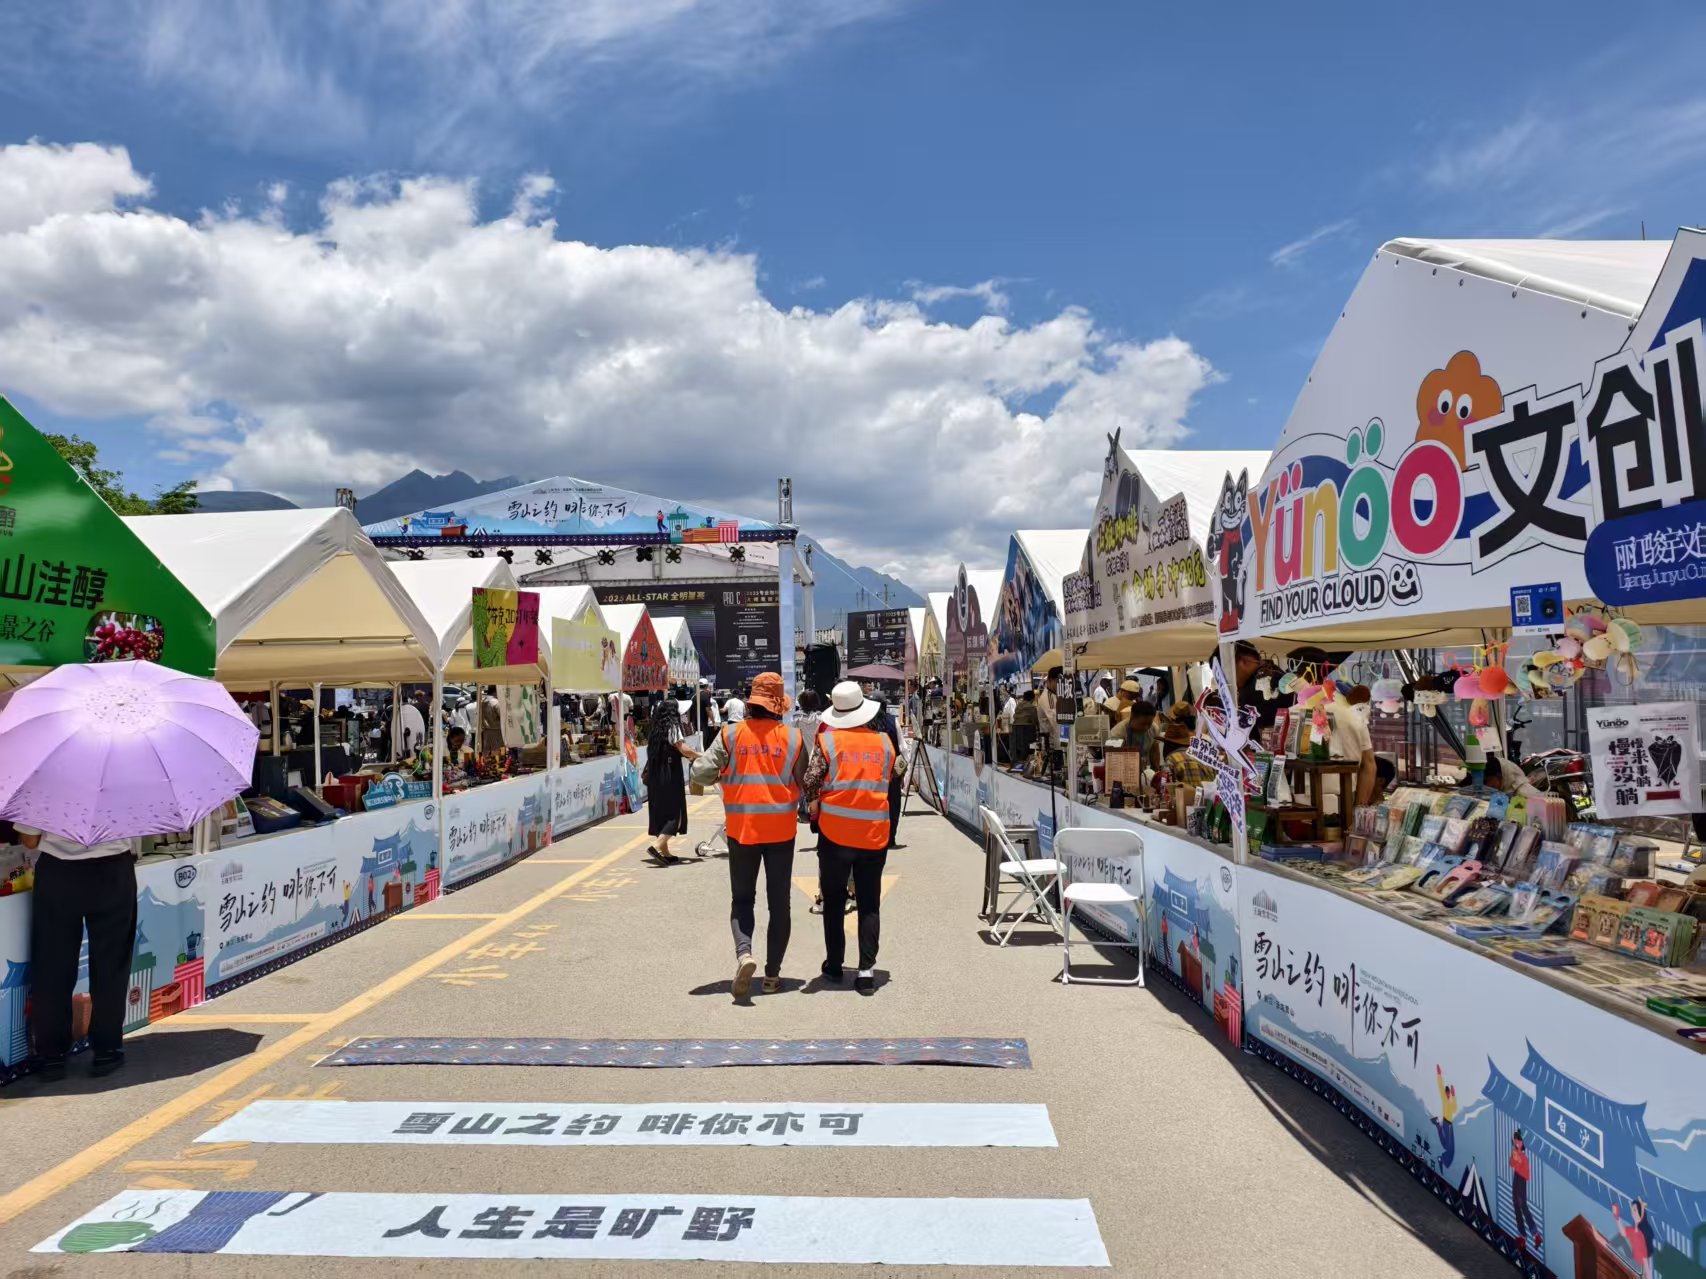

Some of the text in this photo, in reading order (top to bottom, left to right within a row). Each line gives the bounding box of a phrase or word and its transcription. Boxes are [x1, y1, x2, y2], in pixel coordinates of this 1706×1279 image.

[1472, 337, 1700, 560] 文创
[507, 497, 628, 527] 雪山之约 啡你不可
[625, 593, 668, 601] ALL-STAR
[1260, 574, 1386, 624] FIND YOUR CLOUD
[219, 865, 337, 933] 雪山之约 啡你不可
[1253, 931, 1325, 1008] 雪山之约
[1333, 961, 1422, 1069] 啡你不可
[392, 1111, 864, 1136] 雪山之约 啡你不可
[381, 1205, 756, 1242] 人生是旷野
